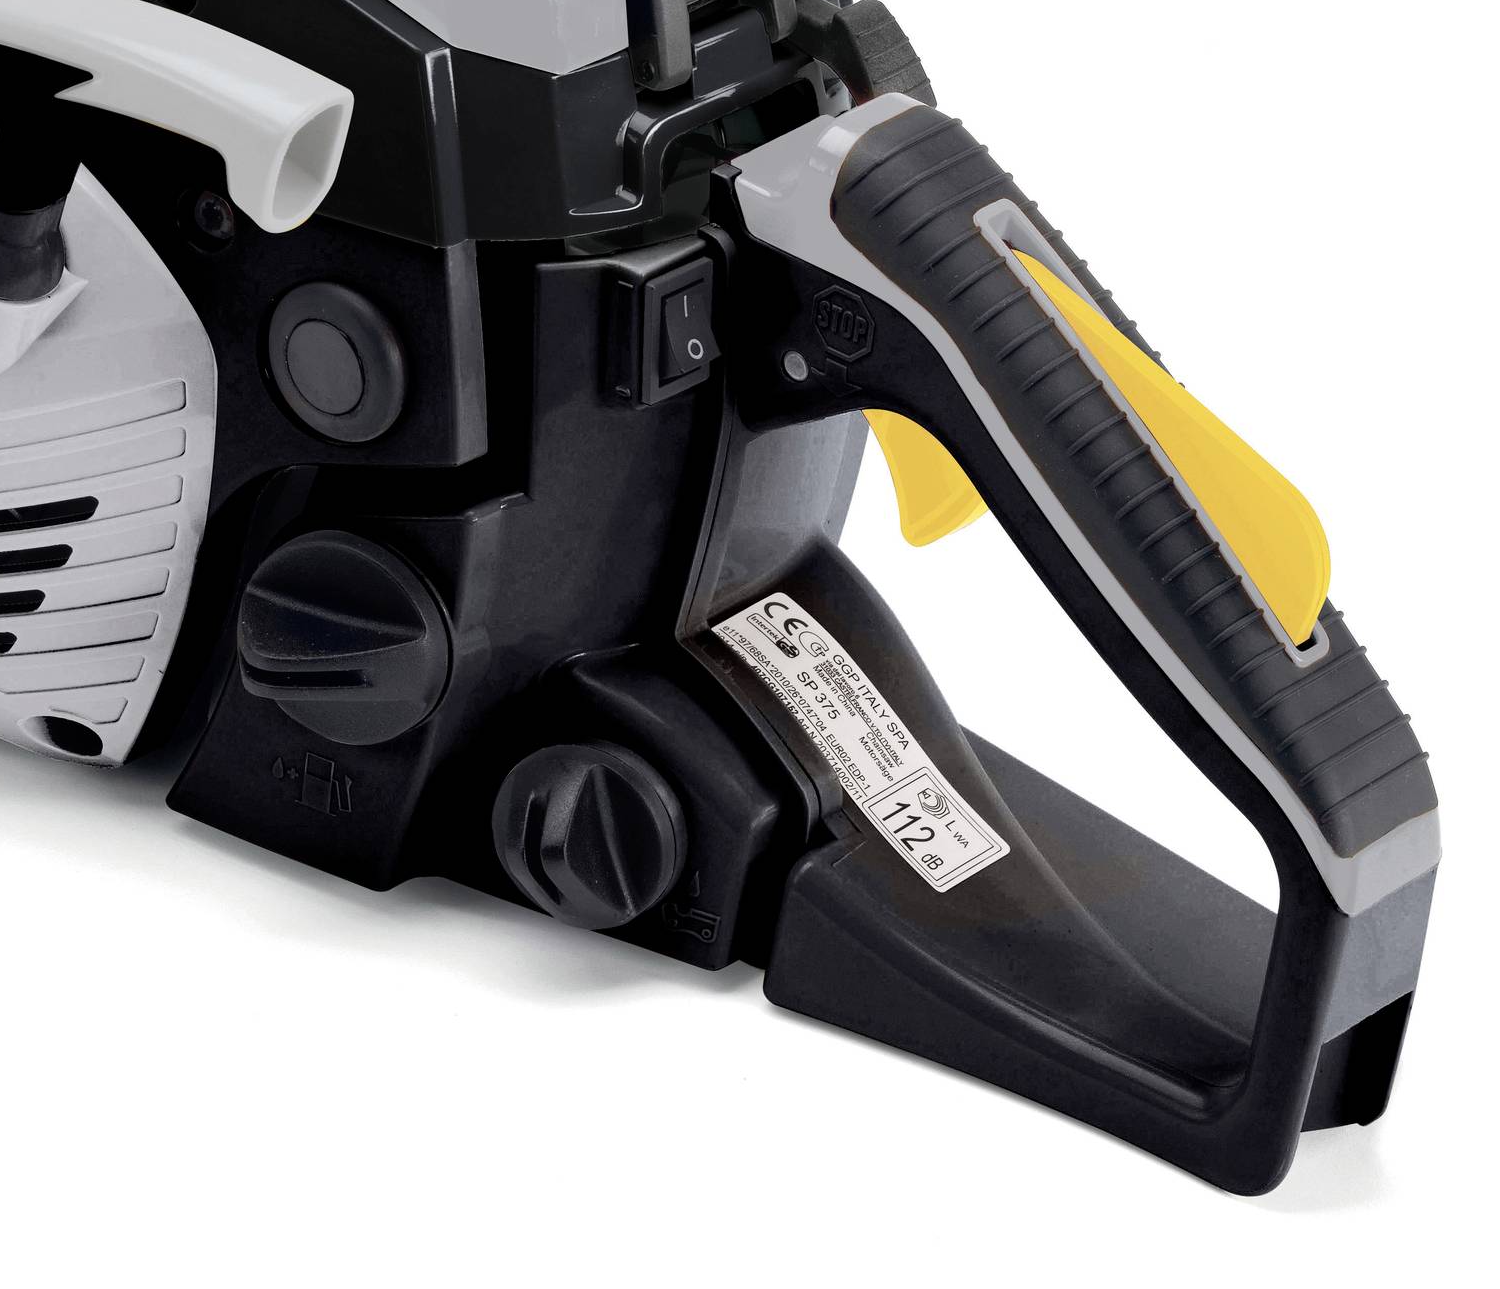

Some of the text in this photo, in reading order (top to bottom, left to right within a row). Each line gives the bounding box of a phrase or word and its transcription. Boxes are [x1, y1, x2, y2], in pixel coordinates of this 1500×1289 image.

[817, 300, 870, 344] STOP
[750, 616, 780, 641] Intertek
[797, 672, 818, 691] SP
[815, 693, 840, 719] 375
[813, 665, 831, 686] Made
[831, 686, 839, 695] in
[838, 694, 856, 717] China
[833, 654, 909, 750] GGP ITALY SPA
[866, 731, 895, 768] Chainsaw
[848, 763, 871, 790] EDP-1
[882, 802, 944, 871] 112 dB
[953, 832, 970, 848] WA
